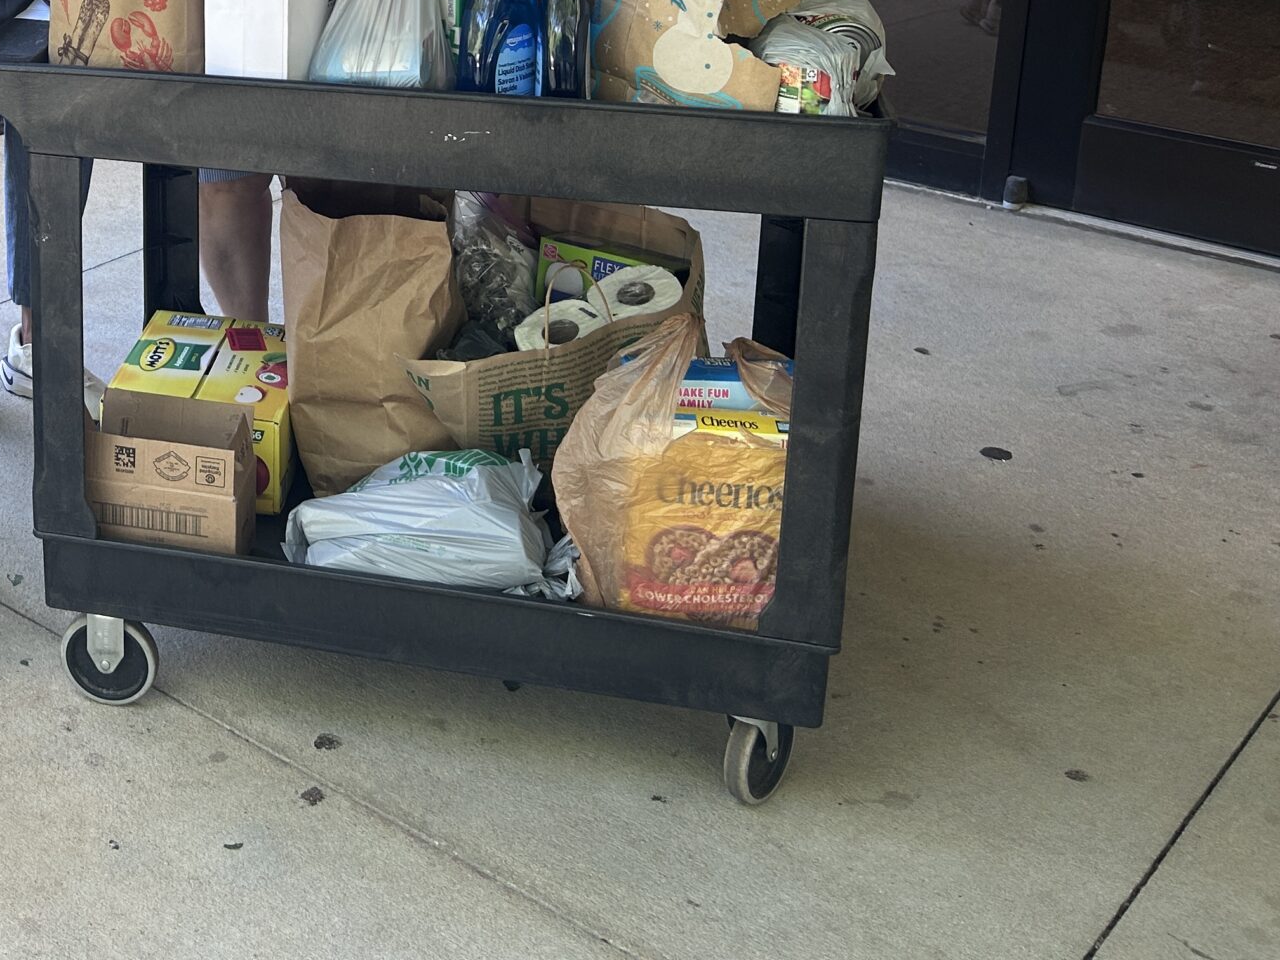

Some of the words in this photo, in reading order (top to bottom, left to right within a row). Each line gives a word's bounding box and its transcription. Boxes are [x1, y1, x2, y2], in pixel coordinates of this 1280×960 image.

[498, 66, 515, 76] Liquid
[145, 341, 170, 368] MOTT'S
[708, 388, 729, 398] FUN
[491, 382, 570, 427] IT'S
[677, 399, 713, 409] AMILY
[638, 588, 683, 604] LOWER
